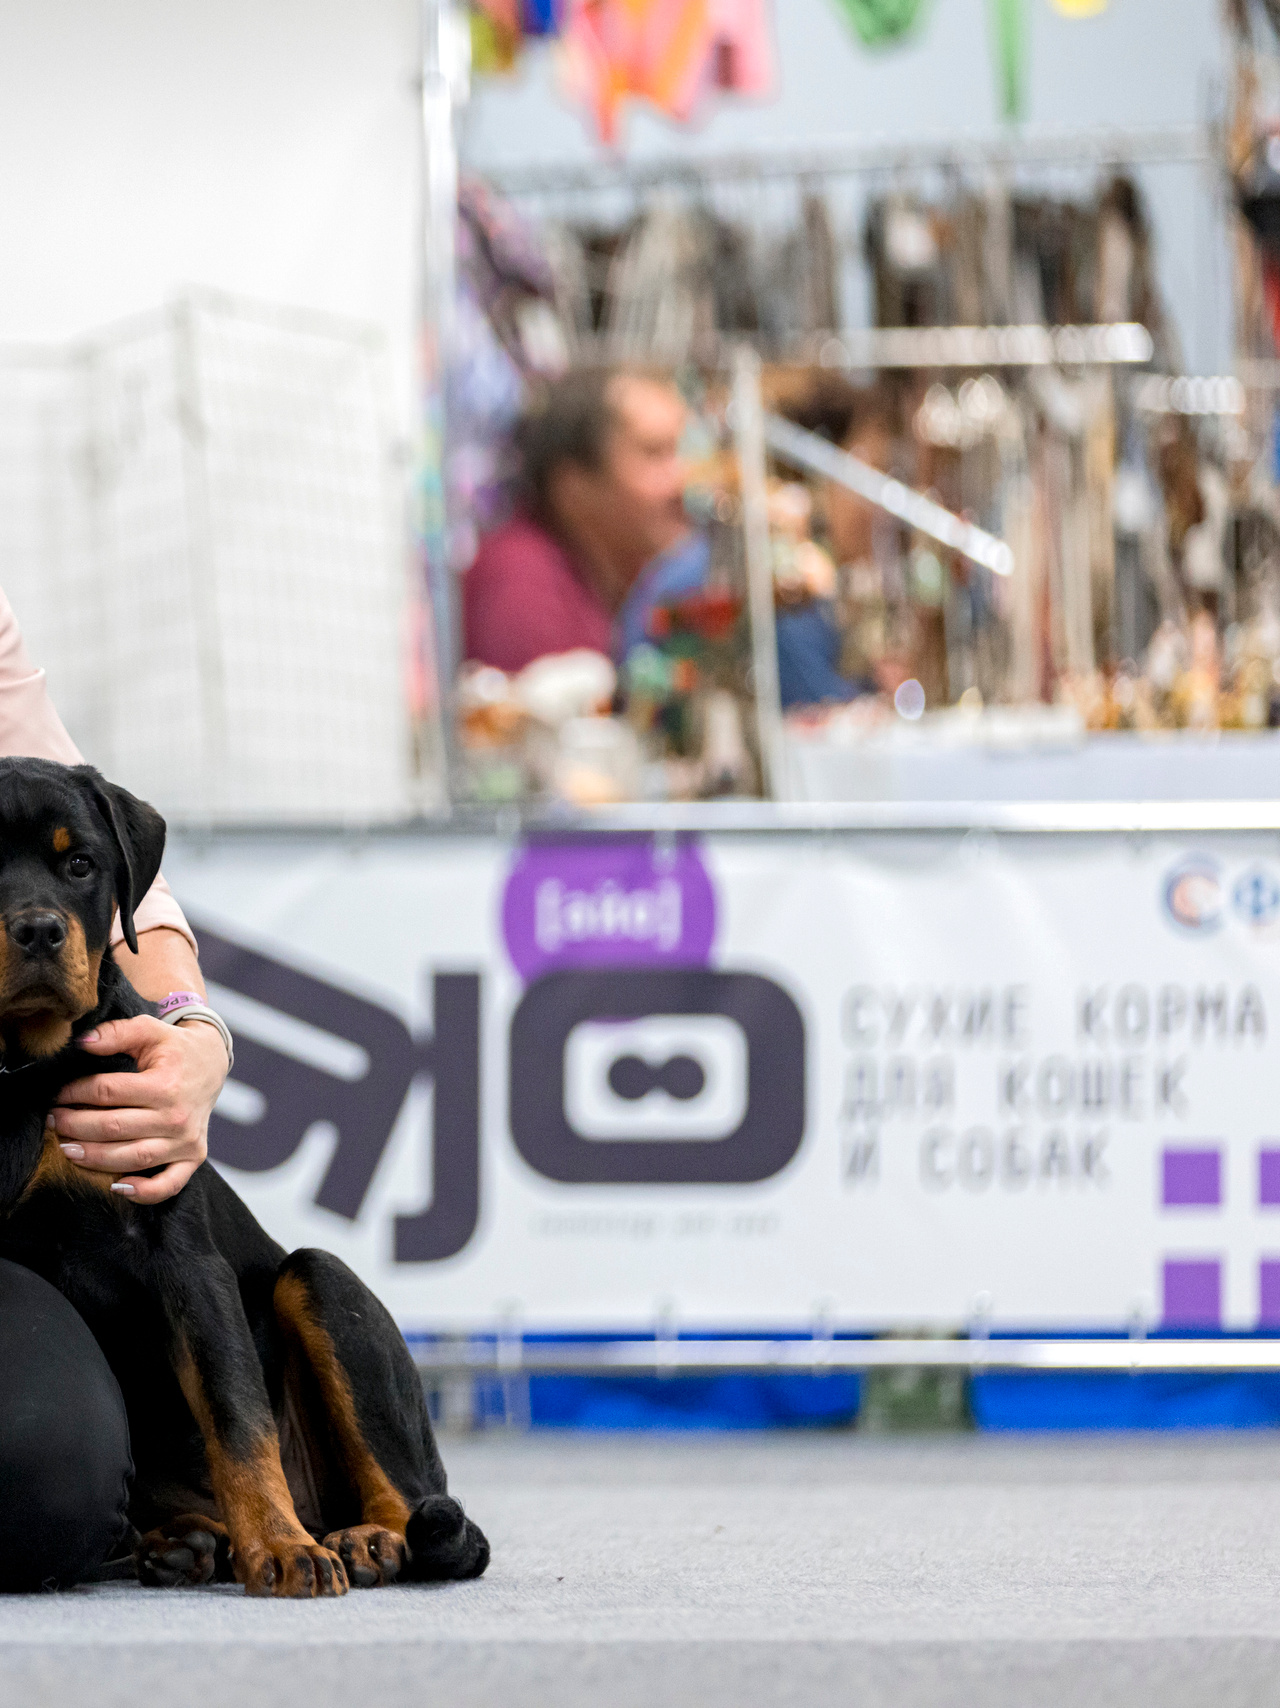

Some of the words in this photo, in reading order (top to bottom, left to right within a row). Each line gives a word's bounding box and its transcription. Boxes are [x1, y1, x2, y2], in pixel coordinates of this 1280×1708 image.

[841, 983, 1031, 1050] СУХИЕ
[1075, 983, 1268, 1048] КОРМА
[839, 1054, 957, 1123] ДЛЯ
[1000, 1054, 1192, 1121] КОШЕК
[921, 1124, 1113, 1193] СОБАК
